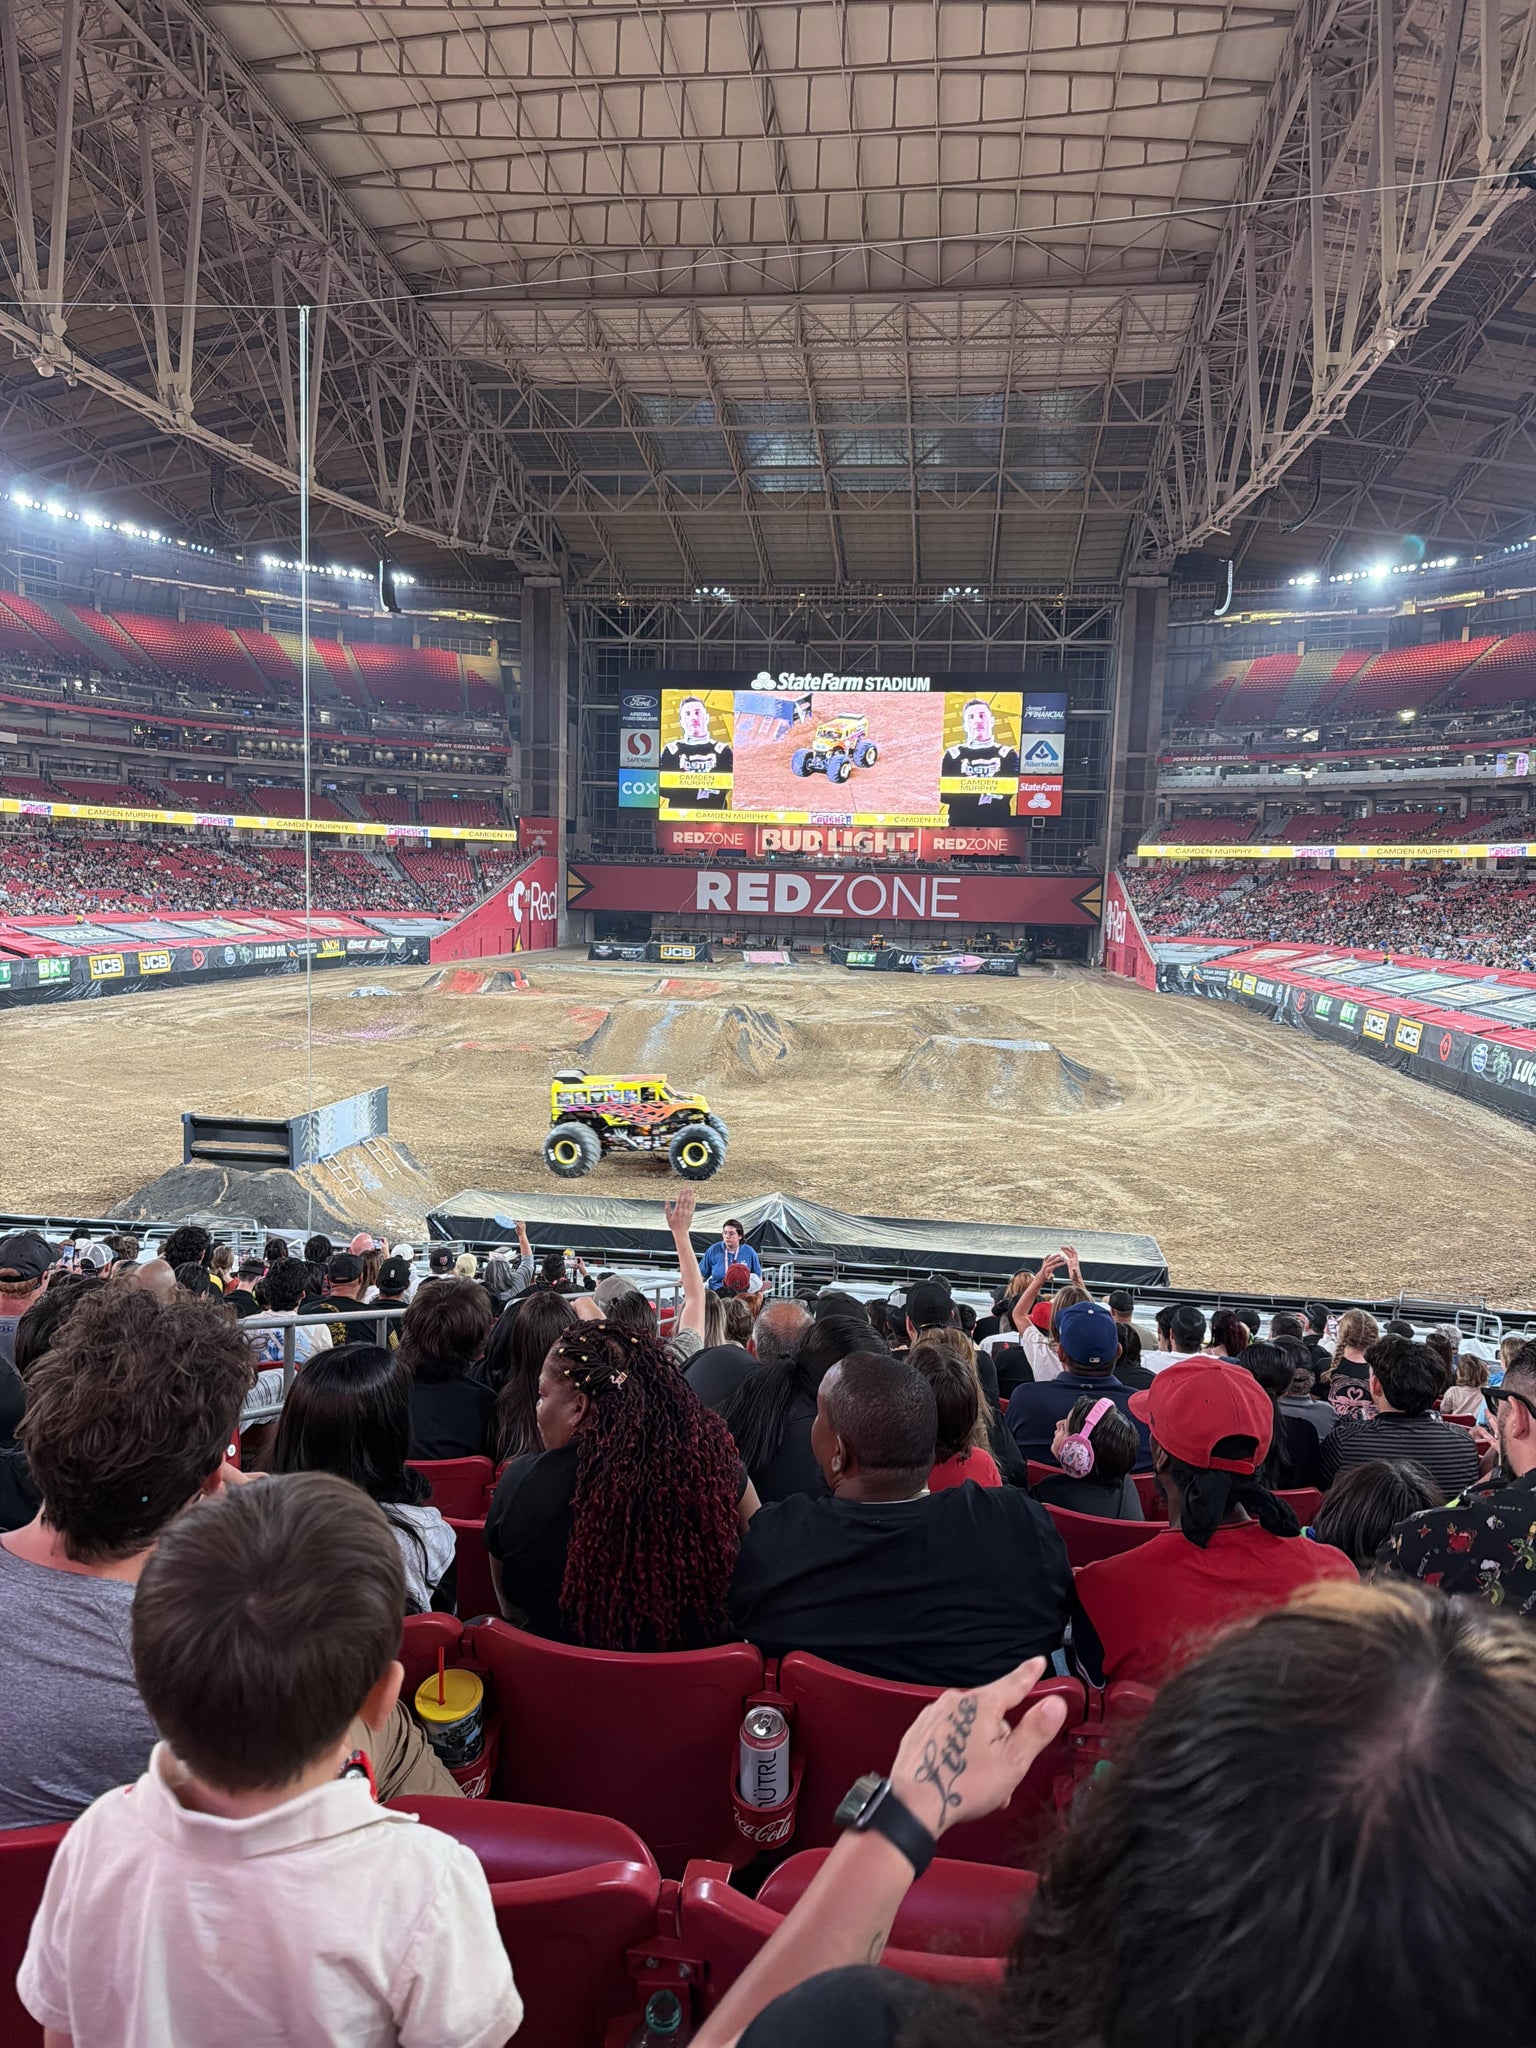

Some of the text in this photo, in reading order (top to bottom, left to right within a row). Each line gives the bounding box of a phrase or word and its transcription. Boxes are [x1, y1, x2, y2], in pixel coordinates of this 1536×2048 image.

[865, 677, 931, 691] STADIUM
[629, 696, 652, 707] Ford
[621, 781, 657, 795] COX
[87, 808, 159, 820] CAMDEN MURPHY
[276, 820, 313, 829] CAMDEN
[468, 830, 502, 838] CAMDEN
[762, 829, 915, 854] BUD LIGHT
[255, 945, 276, 959] LUCAS
[664, 946, 693, 957] JCB
[846, 951, 876, 963] BKT
[38, 960, 70, 978] BKT
[93, 958, 122, 974] JCB
[142, 957, 168, 970] JCB
[1317, 997, 1333, 1014] BKT
[1340, 1003, 1359, 1022] BKT
[1365, 1013, 1388, 1035] JCB
[1397, 1026, 1421, 1047] JCB
